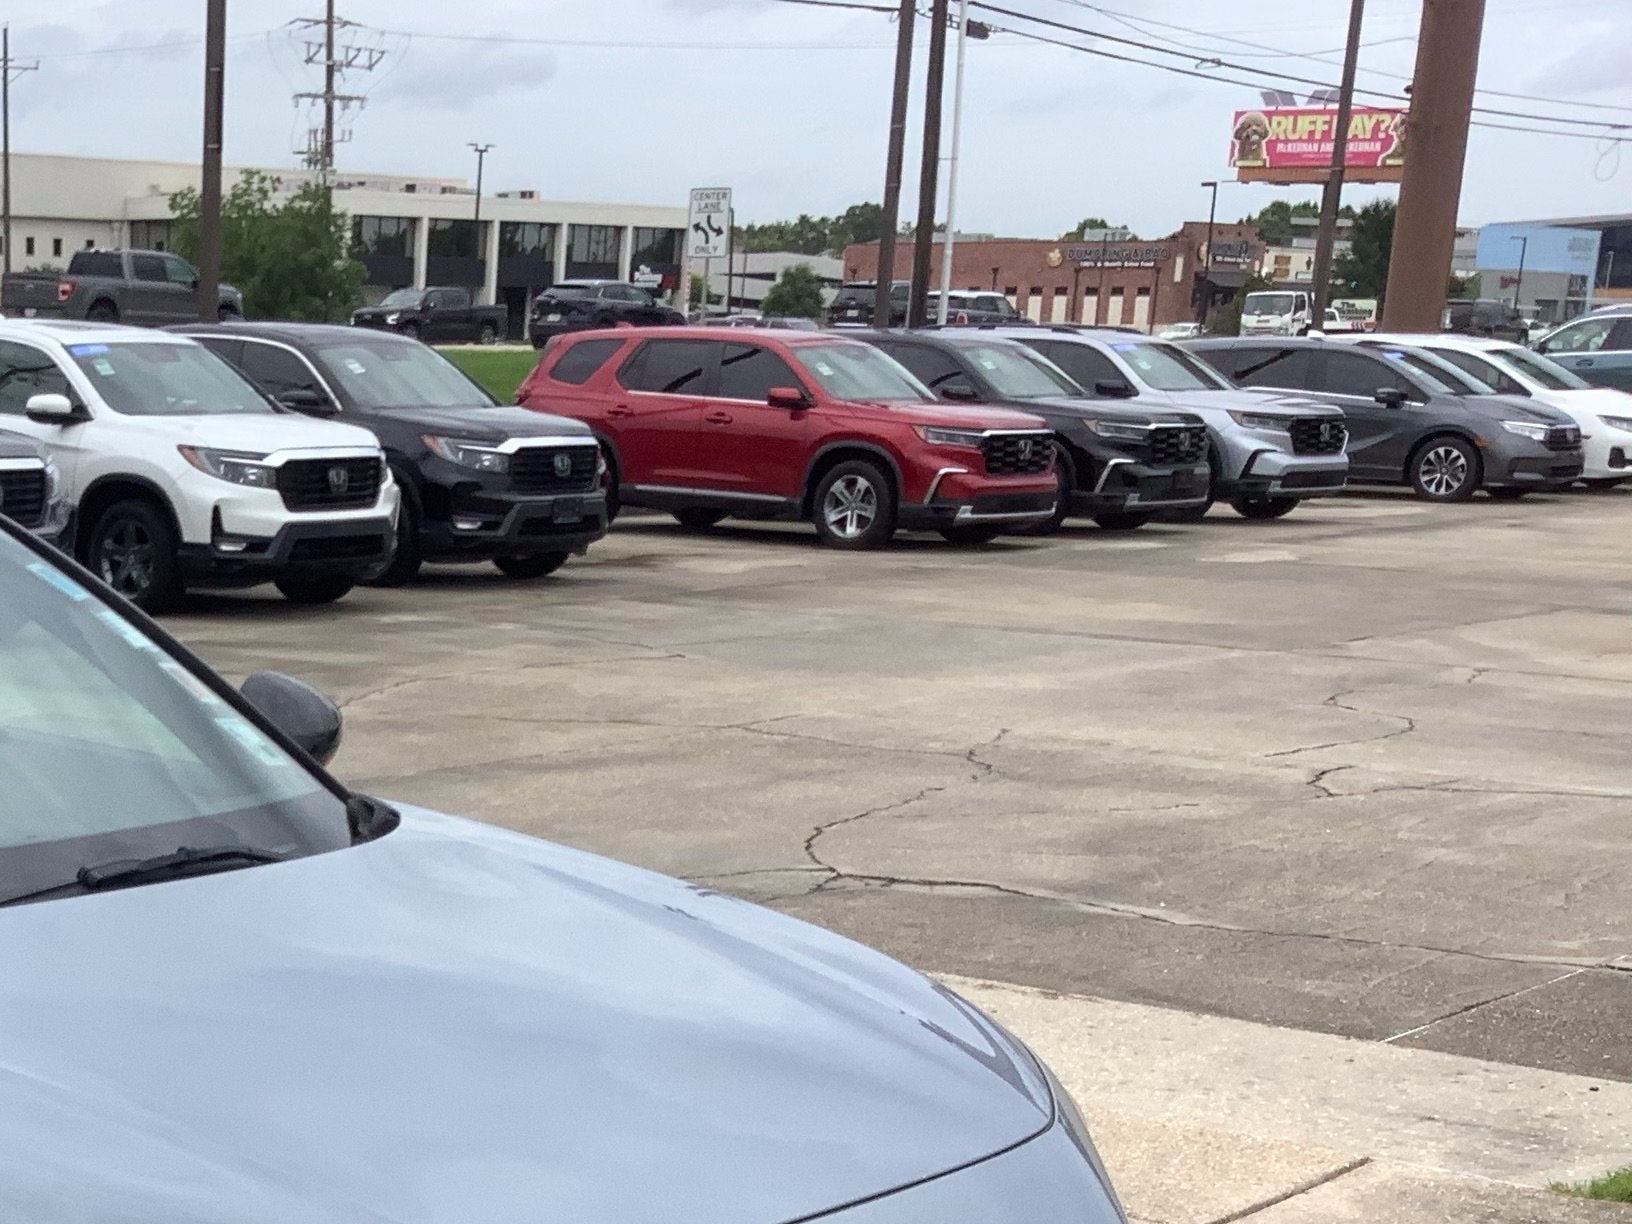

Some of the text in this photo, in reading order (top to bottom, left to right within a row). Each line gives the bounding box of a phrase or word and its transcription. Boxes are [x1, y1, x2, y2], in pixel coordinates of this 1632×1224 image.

[1270, 114, 1331, 140] RUFF
[694, 192, 728, 201] CENTER
[698, 202, 721, 211] LANE
[694, 246, 719, 254] ONLY
